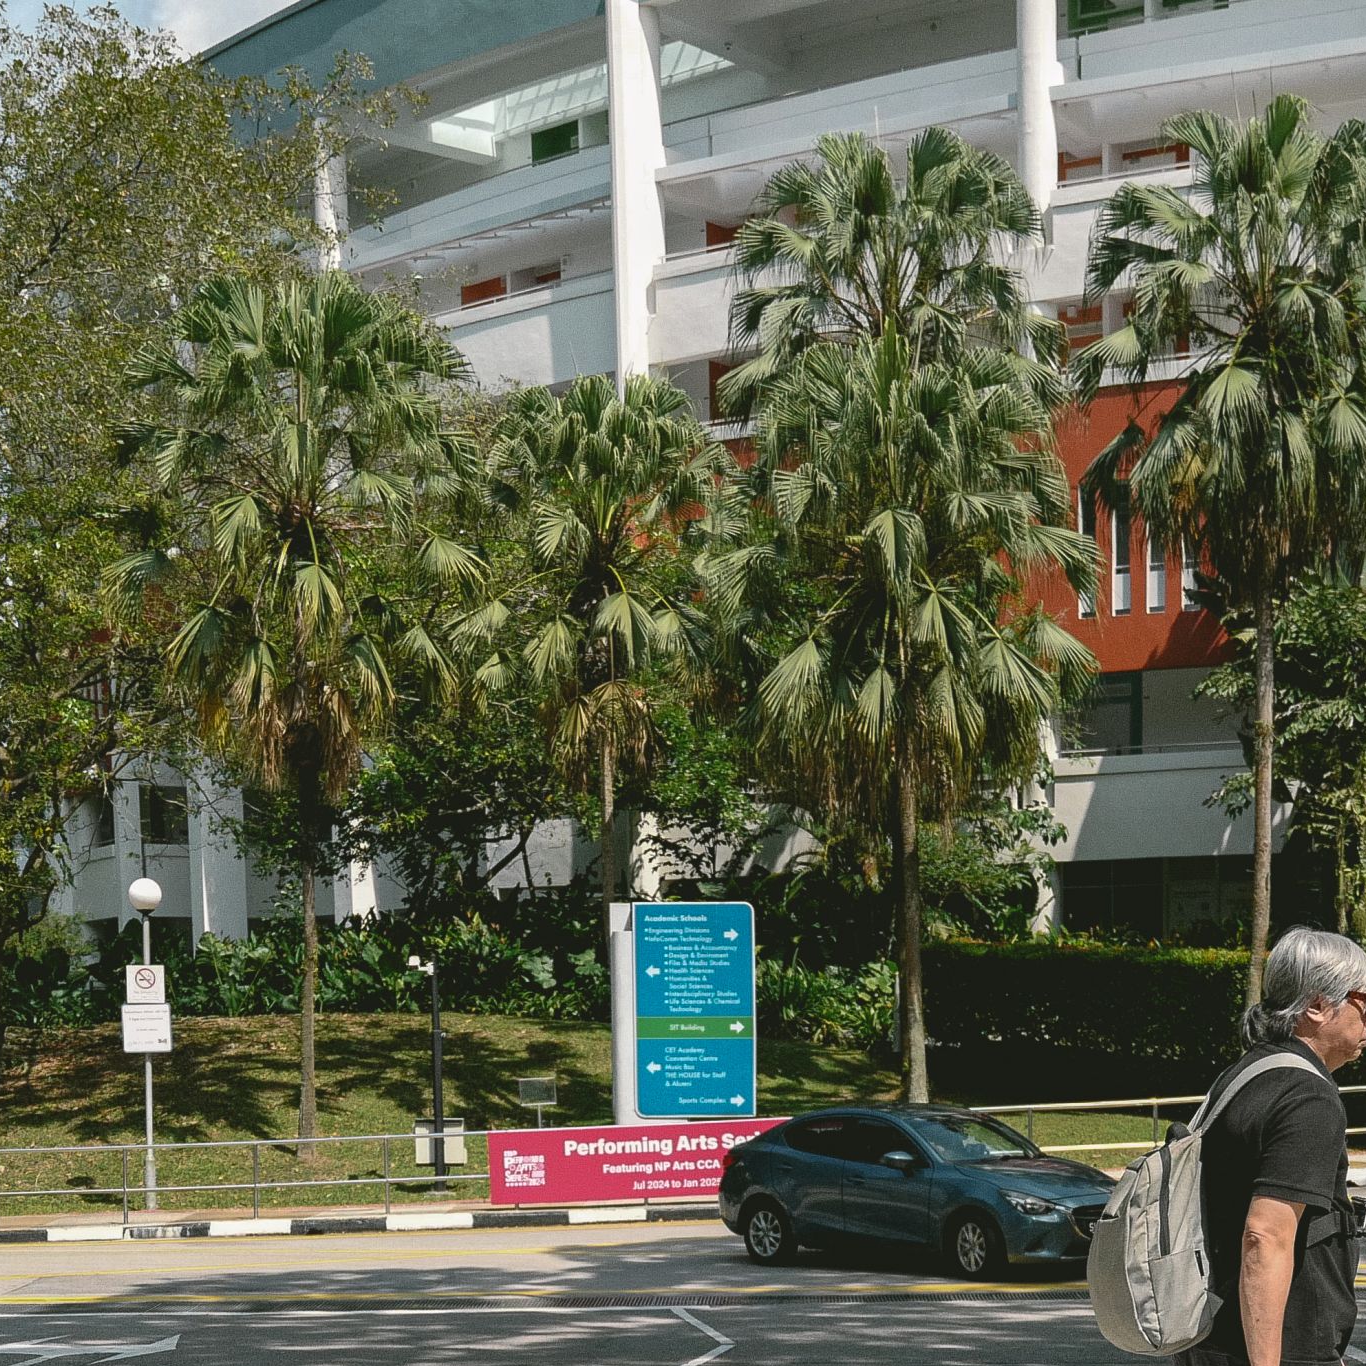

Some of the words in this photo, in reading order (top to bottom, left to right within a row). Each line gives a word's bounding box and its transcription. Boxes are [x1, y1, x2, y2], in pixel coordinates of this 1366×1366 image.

[644, 914, 678, 922] Academic
[680, 914, 707, 922] Schools
[648, 927, 683, 935] Engineering
[680, 935, 713, 943] Technology
[701, 944, 737, 952] Accountancy
[669, 952, 689, 960] Design
[669, 982, 687, 990] Social
[688, 982, 713, 990] Sciences
[669, 990, 715, 998] Interdisciplinary
[714, 997, 740, 1005] Chemical
[669, 1005, 702, 1014] Technology
[669, 1023, 679, 1031] SIT
[680, 1023, 705, 1032] Building
[665, 1046, 676, 1054] CET
[677, 1046, 705, 1054] Academy
[665, 1071, 677, 1079] THE
[678, 1071, 701, 1079] HOUSE
[702, 1071, 711, 1079] for
[712, 1071, 726, 1079] Staff
[678, 1097, 698, 1105] Sports
[699, 1096, 727, 1105] Complex
[564, 1137, 673, 1156] Performing
[676, 1135, 718, 1151] Arts
[602, 1161, 653, 1174] Featuring
[654, 1161, 671, 1171] NP
[672, 1160, 696, 1170] Arts
[696, 1159, 721, 1170] CCA
[633, 1180, 646, 1190] Jul
[647, 1180, 670, 1190] 2024
[671, 1179, 681, 1188] to
[682, 1179, 699, 1188] Jan
